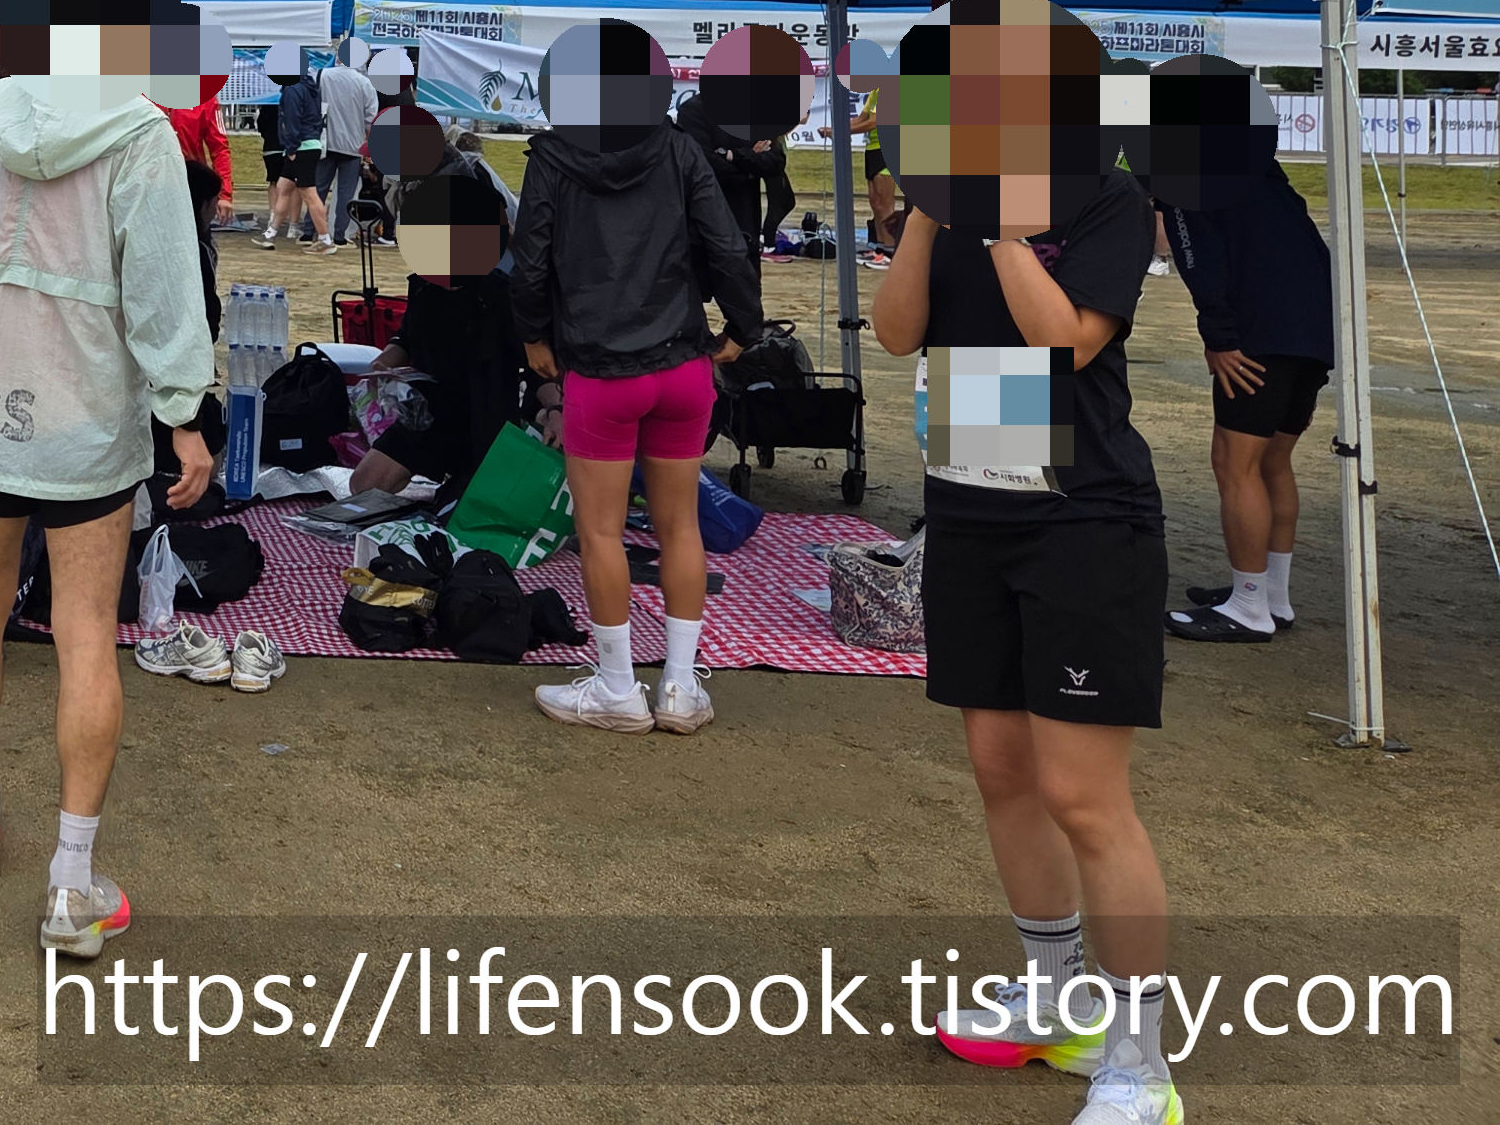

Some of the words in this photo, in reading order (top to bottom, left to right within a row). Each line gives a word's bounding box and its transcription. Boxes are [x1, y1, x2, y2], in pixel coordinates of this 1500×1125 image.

[415, 9, 458, 24] 제11회
[462, 11, 503, 26] 시흥시
[1114, 21, 1159, 36] 제11회
[1162, 23, 1205, 38] 시흥시
[1098, 35, 1205, 54] 하프마라톤대회
[1370, 33, 1500, 58] 시흥서울효
